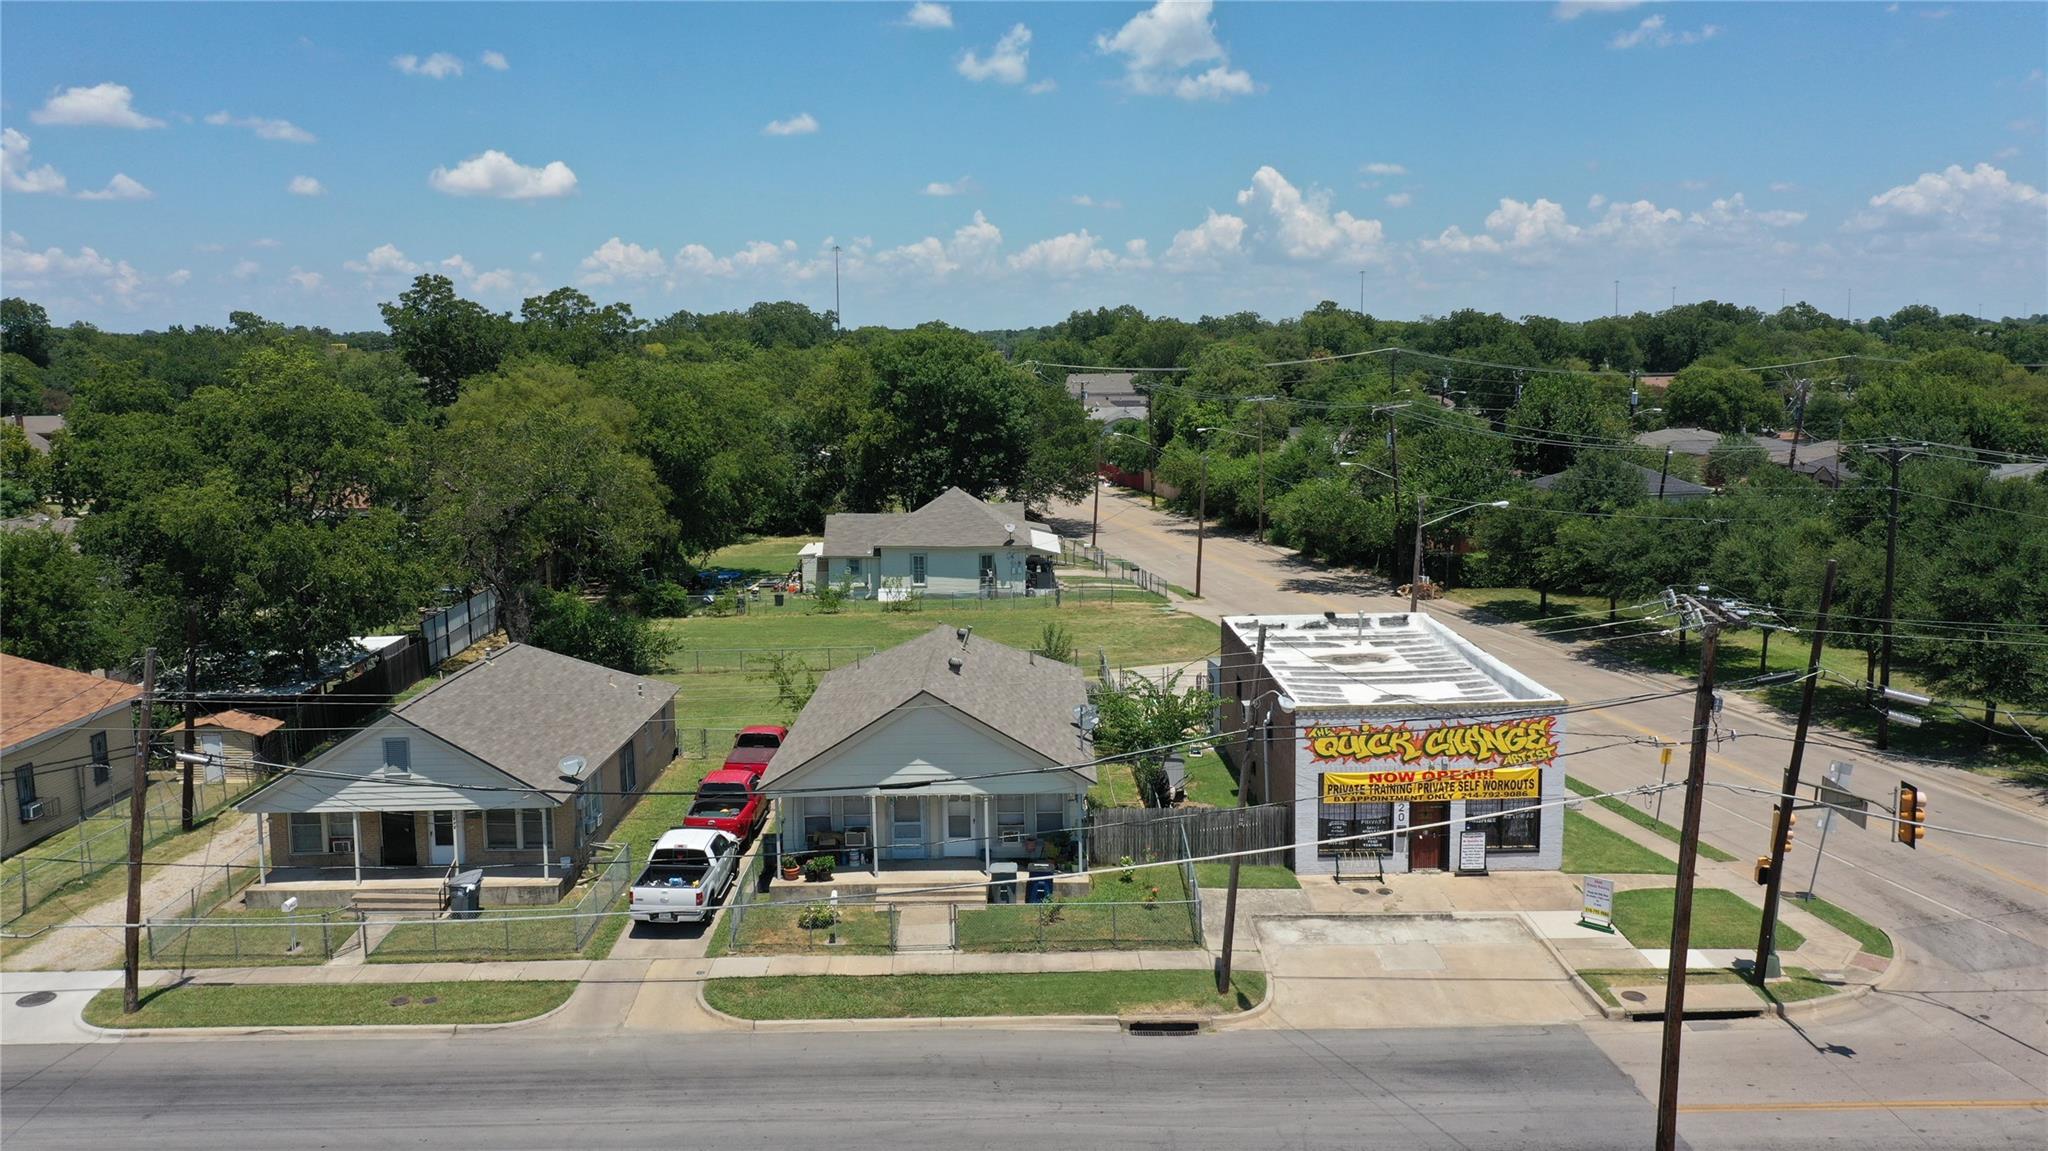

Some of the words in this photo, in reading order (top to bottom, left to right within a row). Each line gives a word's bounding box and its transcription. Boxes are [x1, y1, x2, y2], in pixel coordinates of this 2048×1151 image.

[1308, 728, 1335, 737] THE
[1314, 725, 1422, 761] QUICK
[1425, 719, 1548, 760] CHANGE
[1502, 745, 1557, 765] ARTIST
[1368, 772, 1415, 783] NOW
[1422, 770, 1495, 781] OPEN!!!
[1327, 784, 1366, 795] PRIVATE
[1458, 780, 1480, 792] SELF
[1482, 778, 1535, 791] WORKOUTS
[1461, 791, 1529, 799] 214-792-9086
